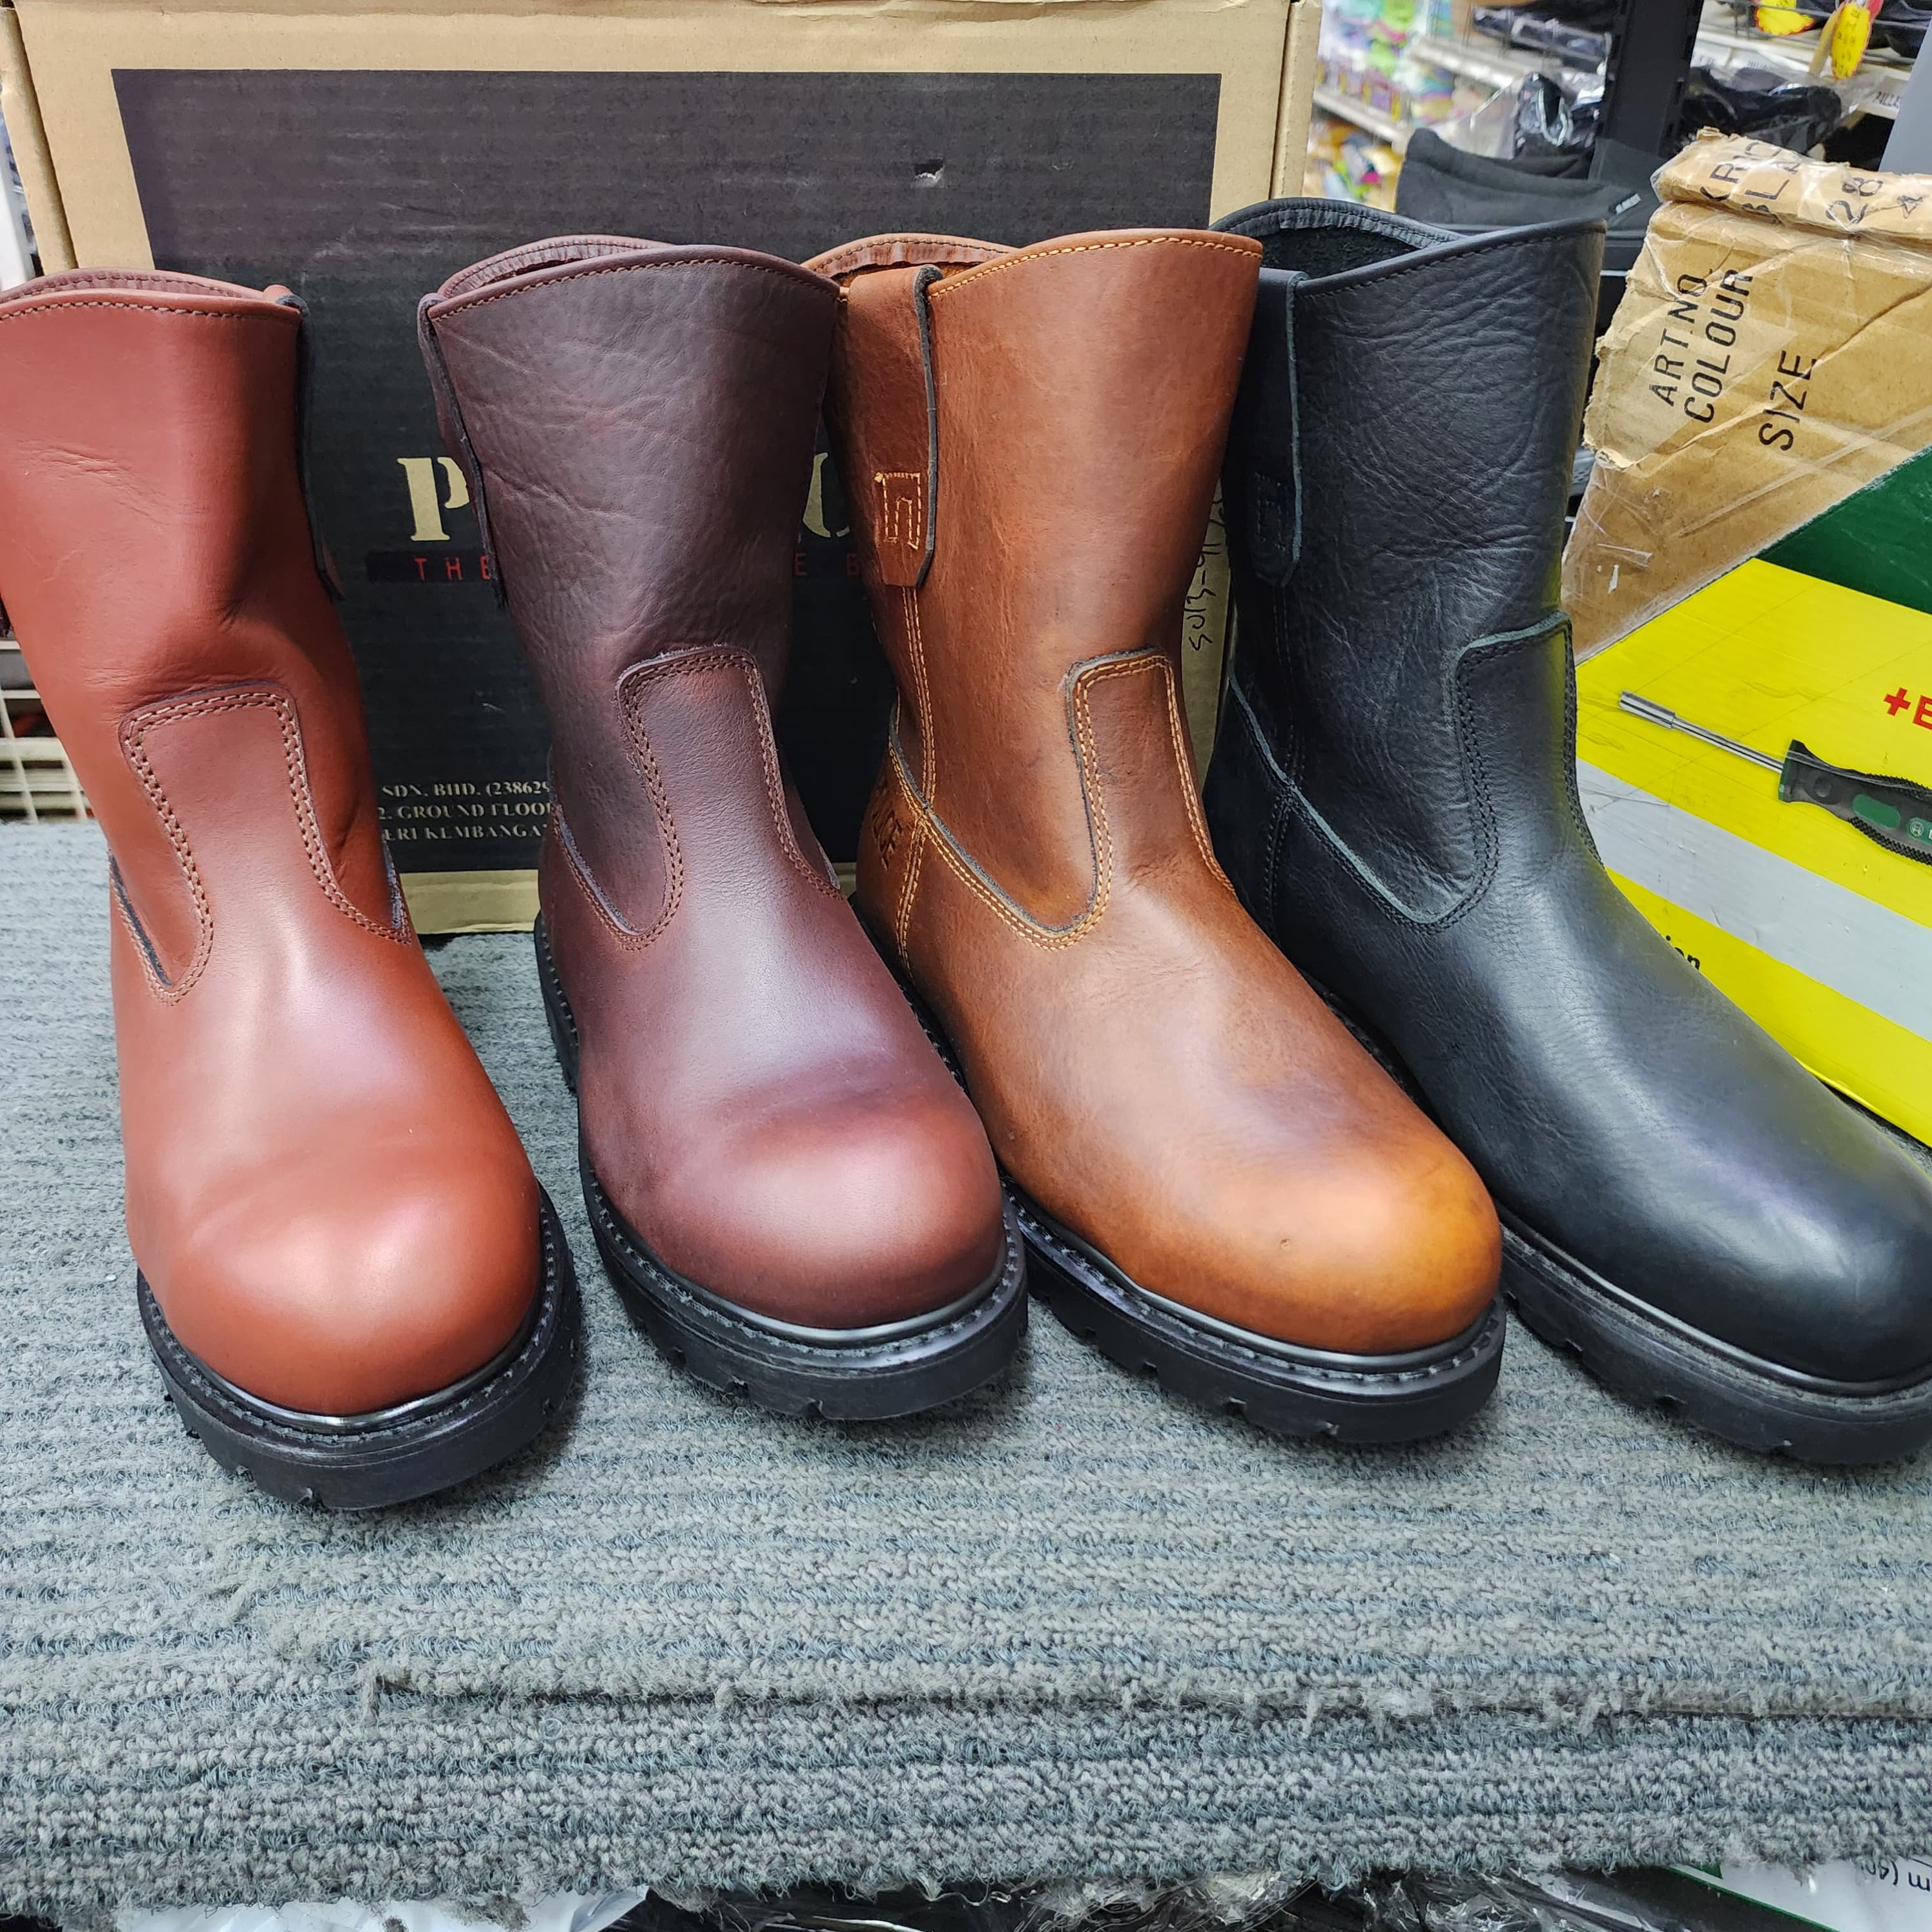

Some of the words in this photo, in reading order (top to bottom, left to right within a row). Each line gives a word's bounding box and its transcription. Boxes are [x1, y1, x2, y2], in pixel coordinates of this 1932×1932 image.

[1649, 328, 1689, 407] ART
[1683, 269, 1753, 423] COLOUR
[1758, 350, 1817, 451] SIZE
[382, 784, 428, 797] SDN.
[397, 805, 484, 818] GROUND
[383, 827, 418, 841] ERI
